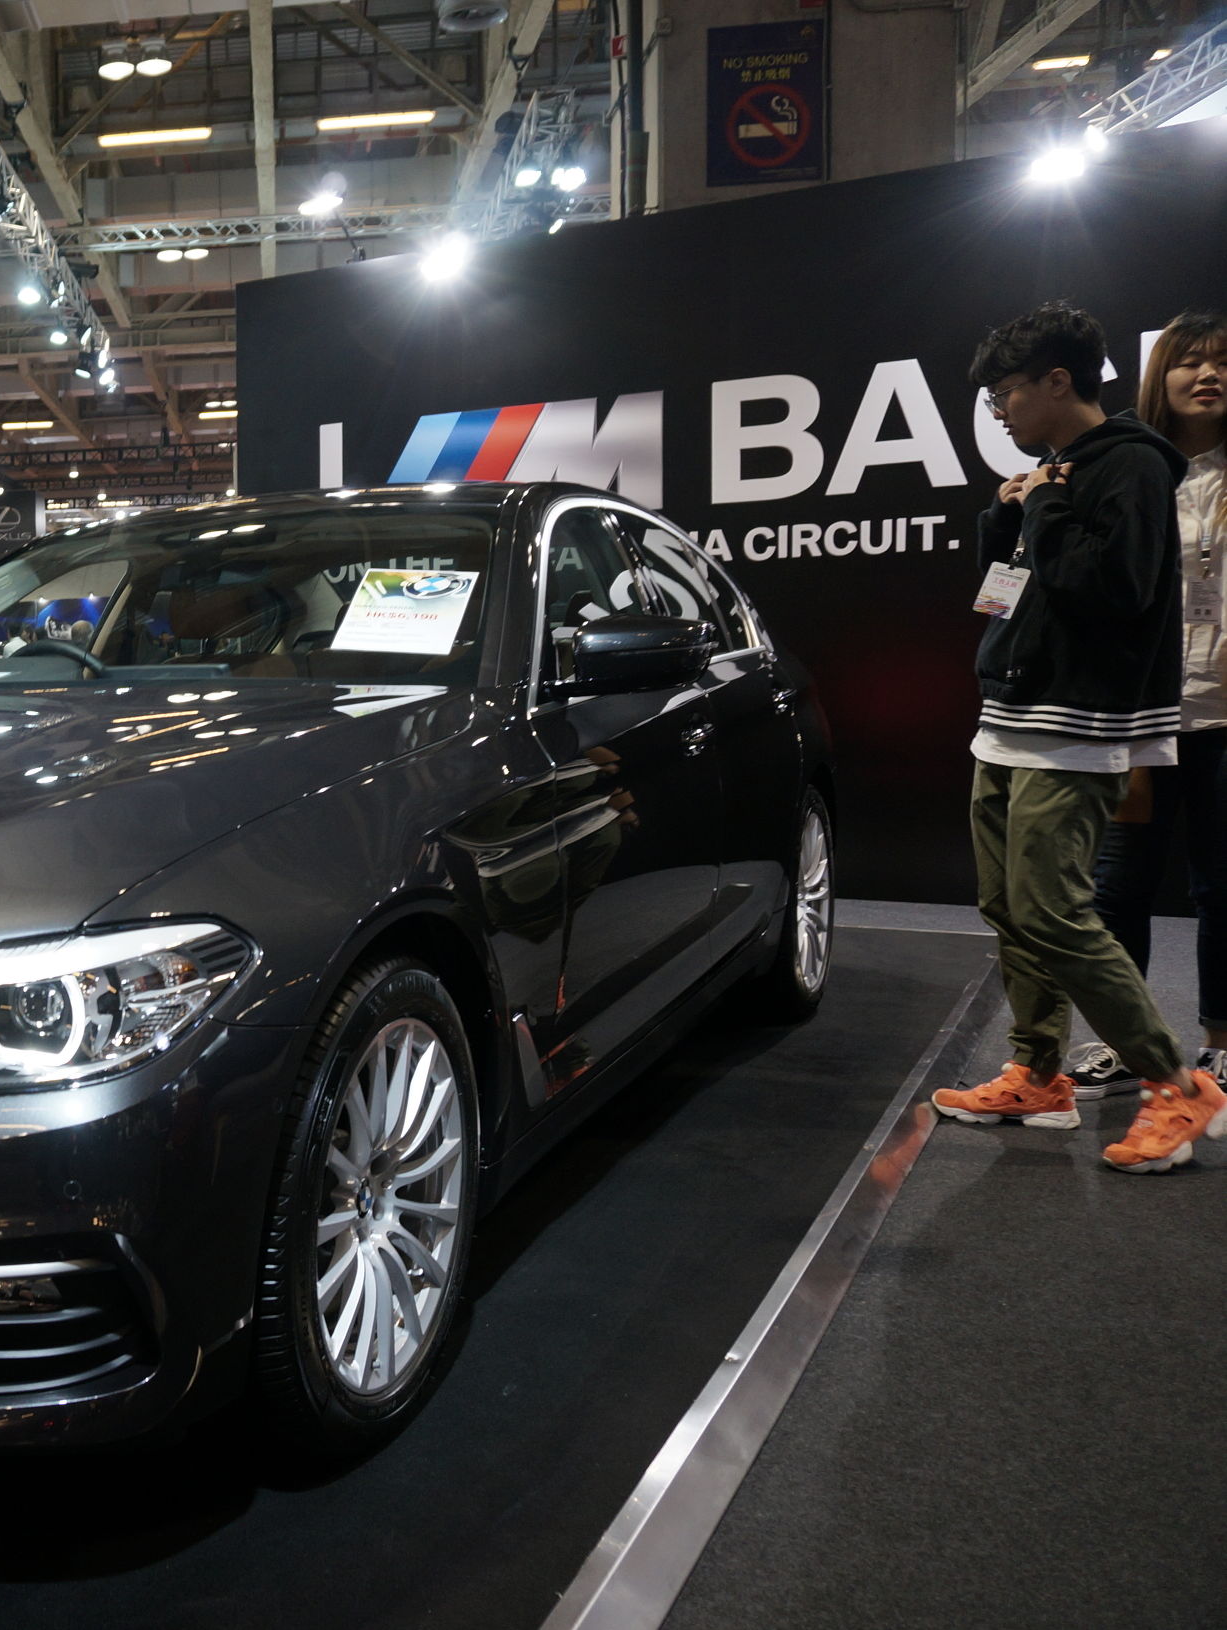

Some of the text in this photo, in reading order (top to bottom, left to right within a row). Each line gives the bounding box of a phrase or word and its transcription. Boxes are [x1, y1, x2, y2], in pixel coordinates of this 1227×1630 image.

[723, 53, 808, 69] NO SMOKING
[743, 515, 960, 562] CIRCUIT.
